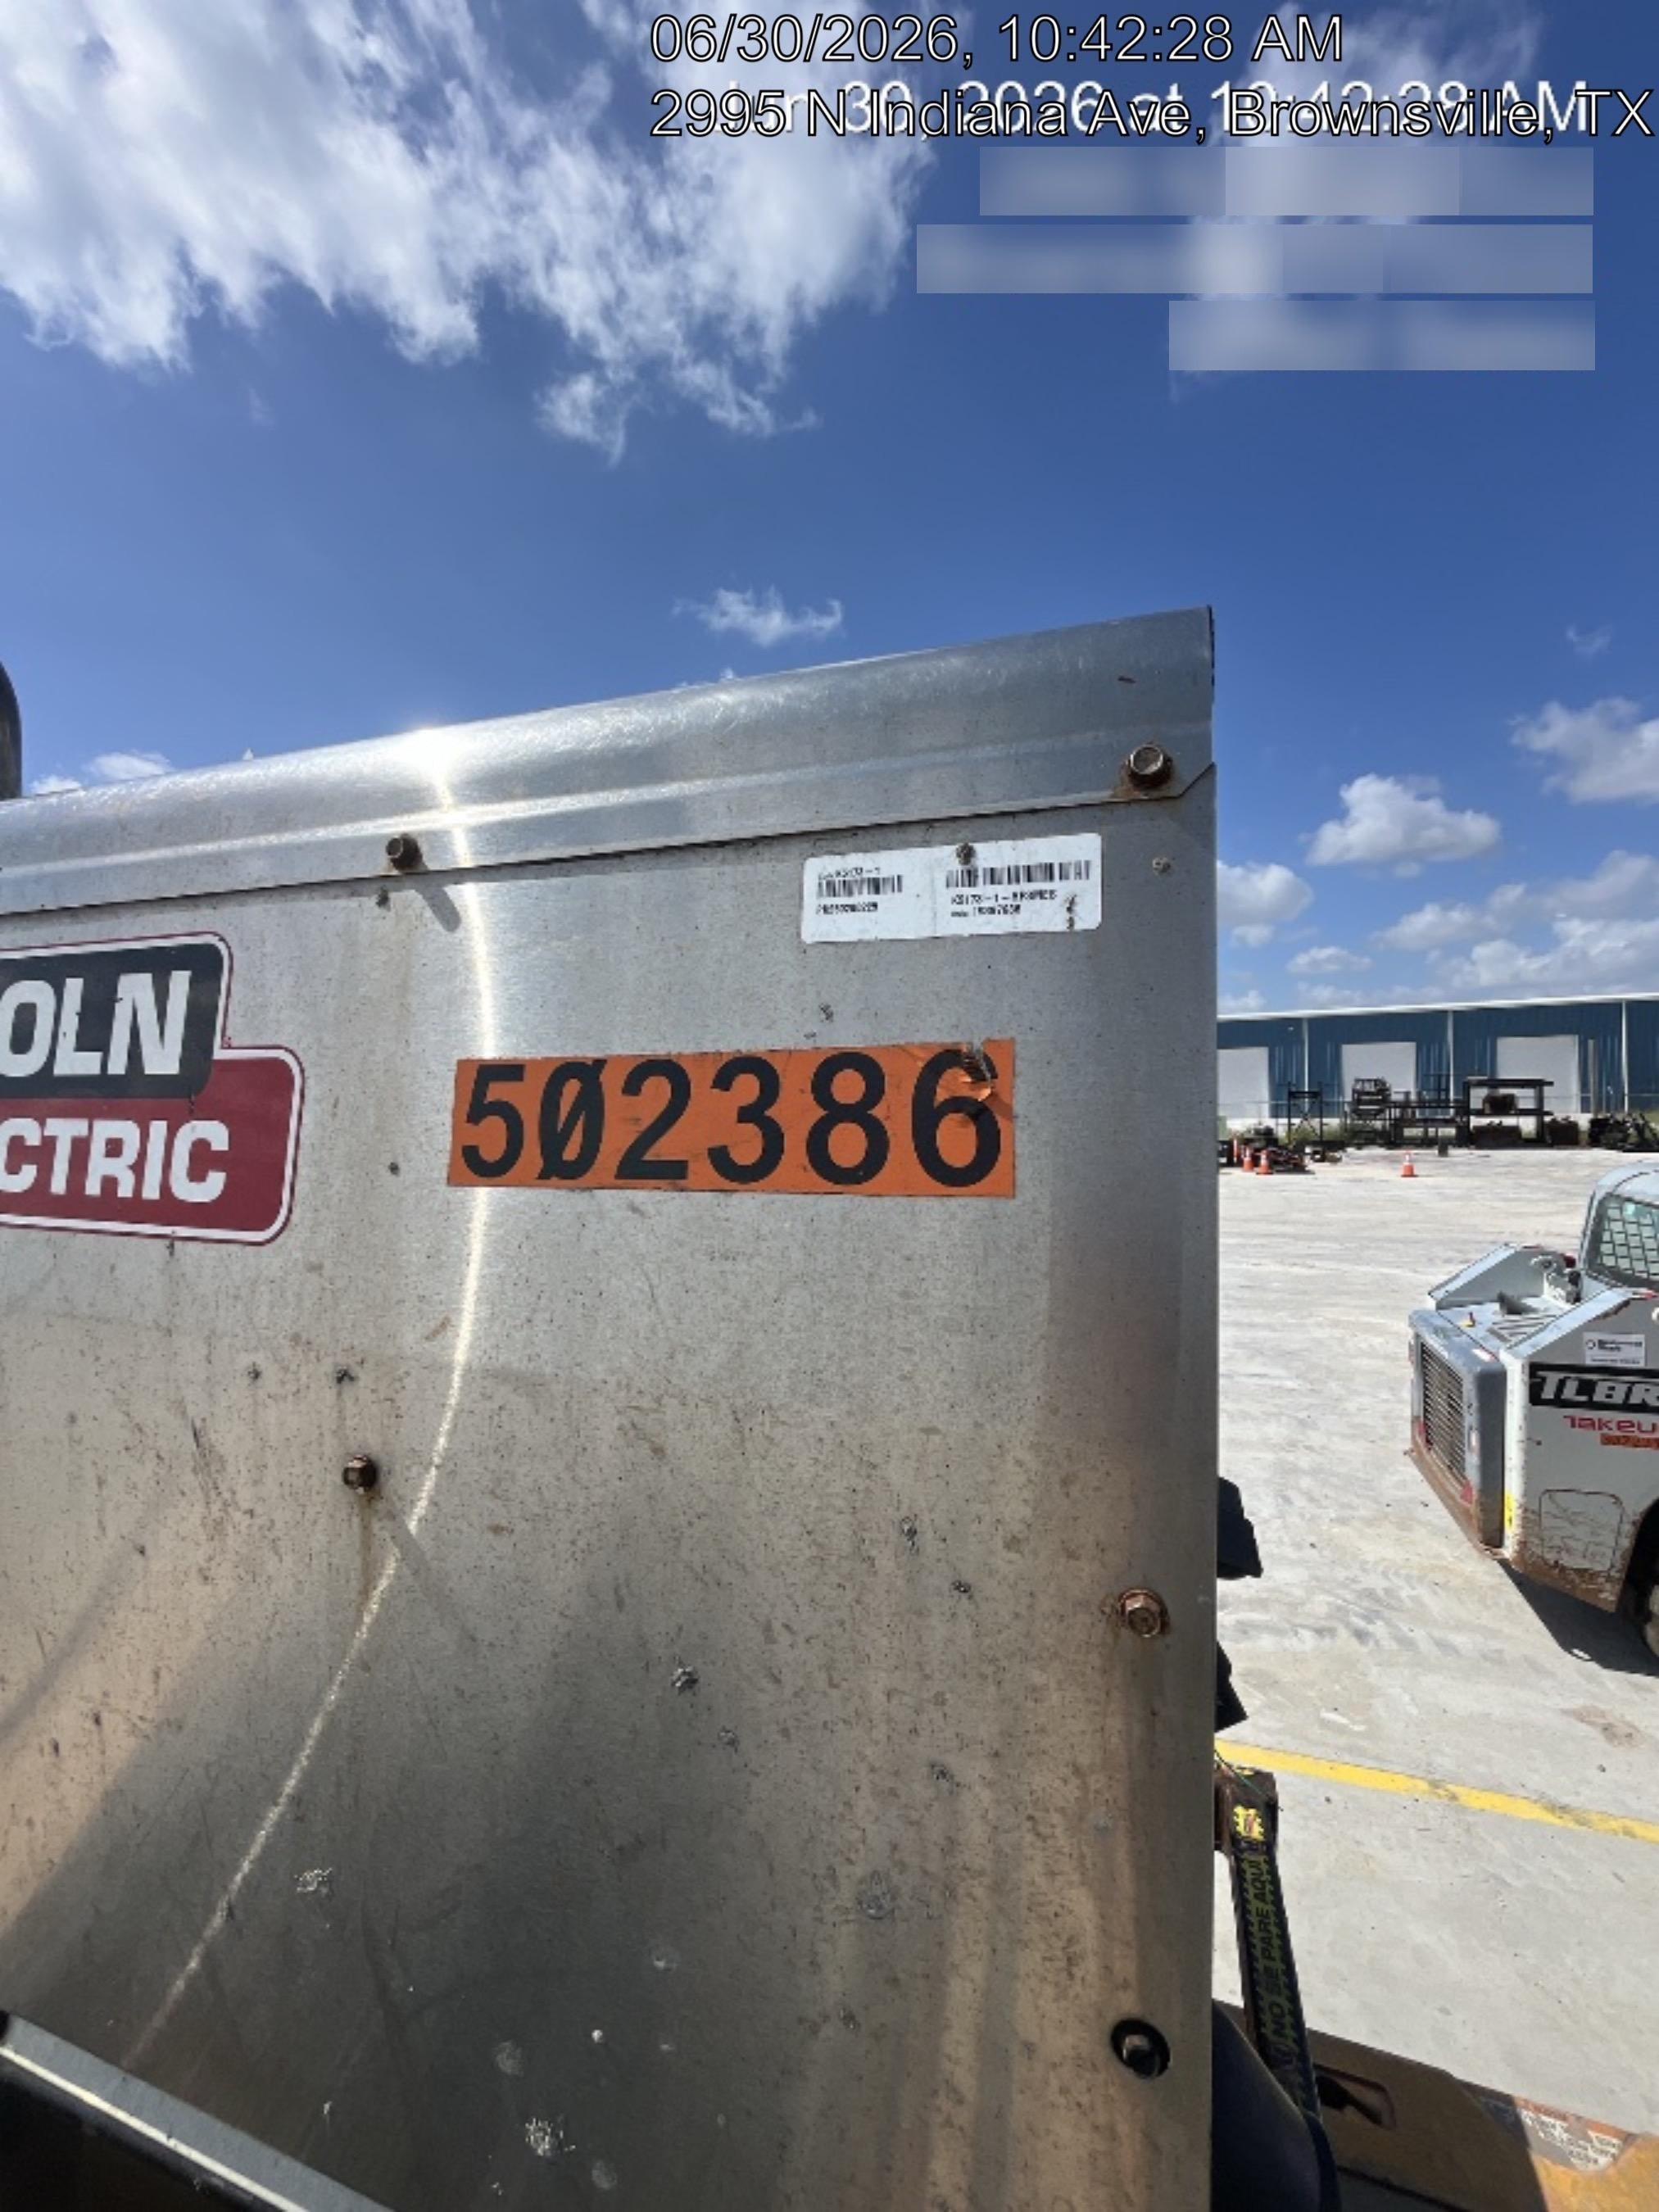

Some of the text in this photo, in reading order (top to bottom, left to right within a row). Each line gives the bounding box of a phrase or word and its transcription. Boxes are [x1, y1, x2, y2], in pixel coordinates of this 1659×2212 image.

[0, 970, 193, 1077] OLN
[0, 1117, 230, 1203] CTRIC
[460, 1049, 1002, 1187] 502386
[1256, 1906, 1274, 1962] PARE
